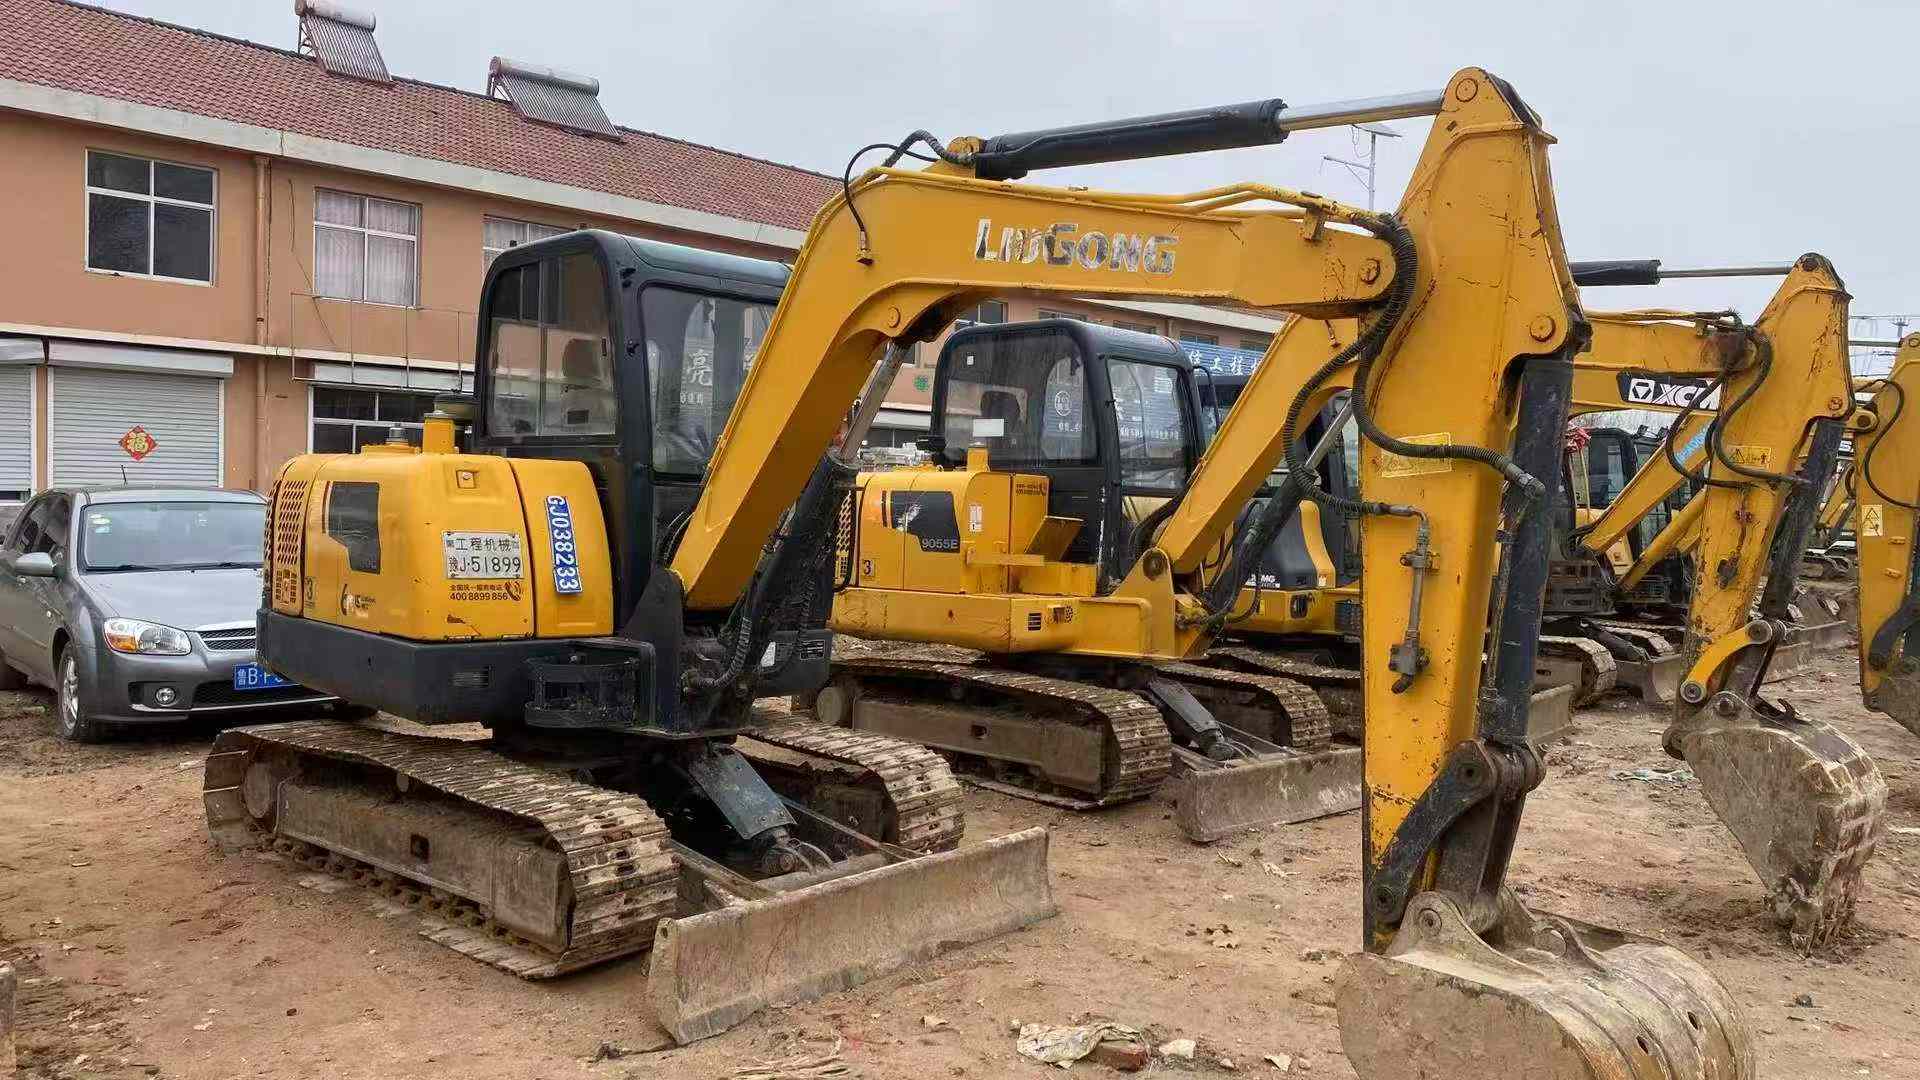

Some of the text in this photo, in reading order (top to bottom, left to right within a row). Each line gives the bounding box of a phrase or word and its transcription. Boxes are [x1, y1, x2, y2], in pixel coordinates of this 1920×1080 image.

[456, 537, 511, 551] 工程机械
[547, 495, 579, 589] GJ038233
[922, 538, 959, 550] 9055E
[449, 592, 467, 601] 400
